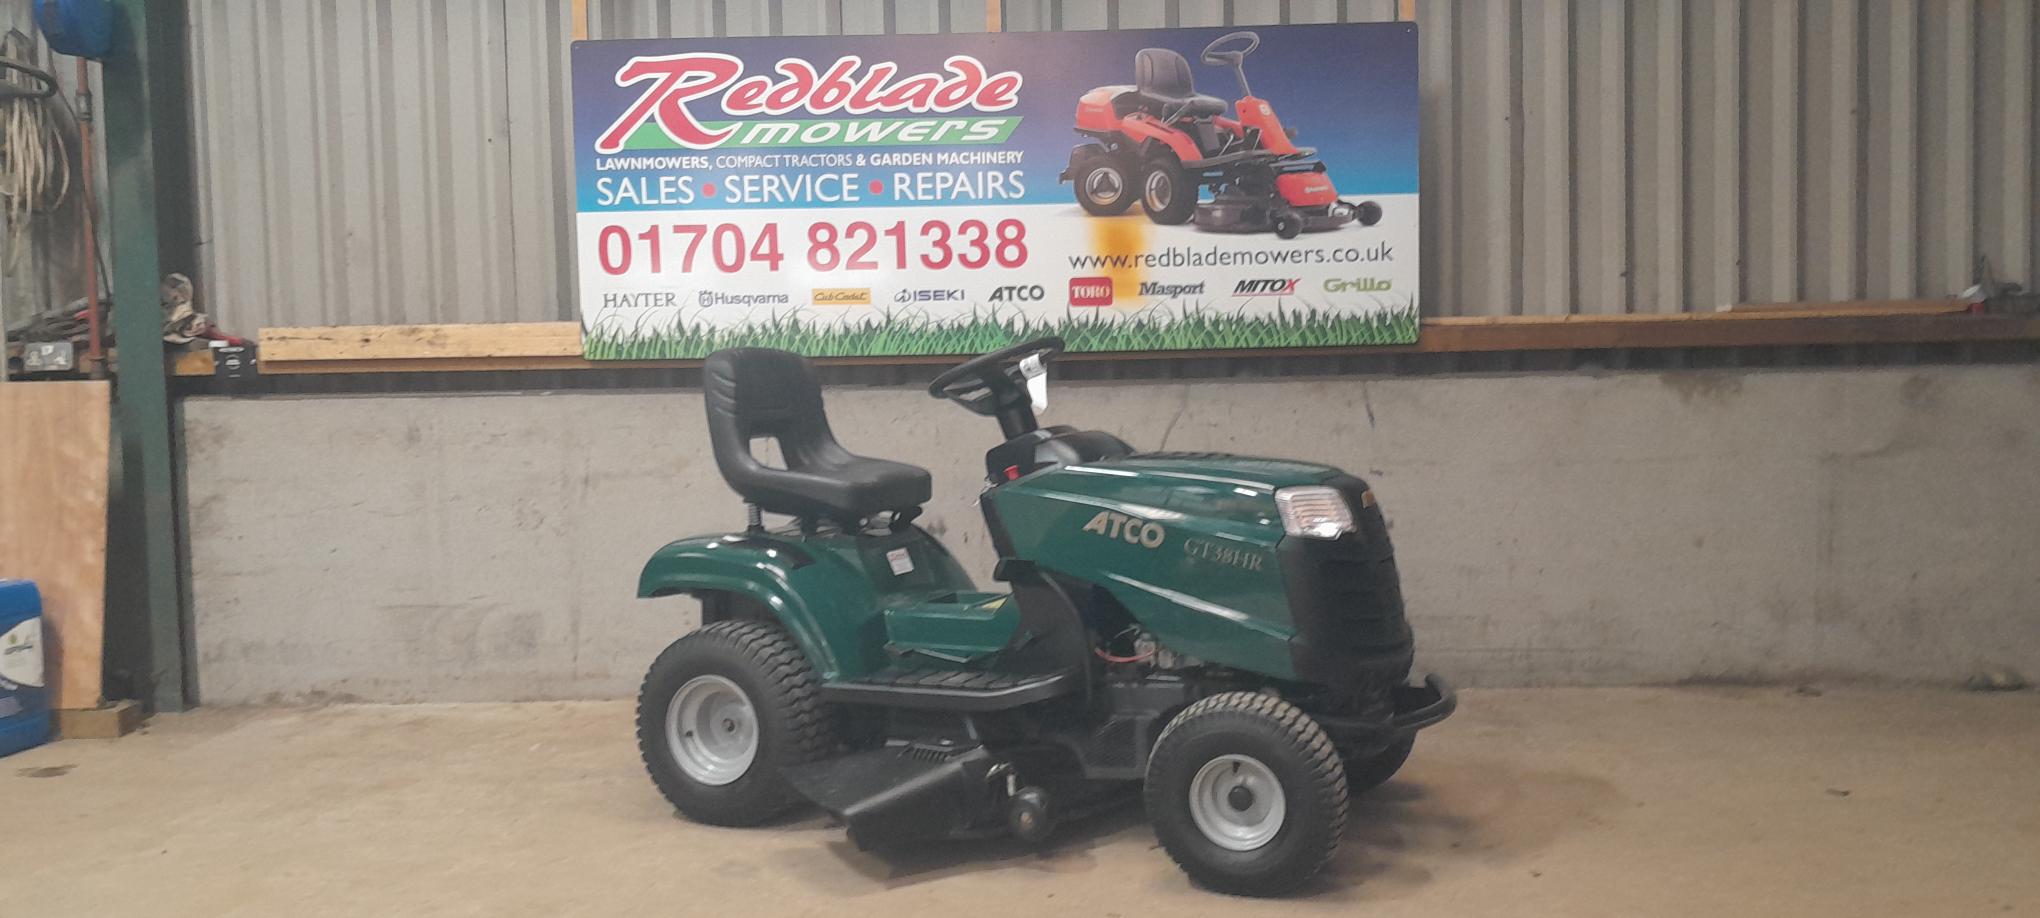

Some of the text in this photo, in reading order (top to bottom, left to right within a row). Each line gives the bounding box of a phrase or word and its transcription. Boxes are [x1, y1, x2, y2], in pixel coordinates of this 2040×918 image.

[595, 52, 1023, 154] Redblade
[596, 150, 1024, 171] LAWNMOWERS, COMPACT TRACTORS & GARDEN MACHINERY
[596, 170, 1025, 206] SALES SERVICE REPAIRS
[598, 218, 1028, 275] 01704 821338
[1068, 241, 1393, 270] www.redblademowers.co.uk
[988, 285, 1045, 302] ATCO
[1071, 285, 1111, 299] TORO
[1138, 280, 1205, 299] Masport
[1233, 277, 1301, 294] MITOX
[1322, 278, 1393, 292] Grillo
[603, 292, 677, 308] HAYTER
[715, 293, 789, 306] Husqvarna
[913, 289, 965, 301] ISEKI
[1083, 510, 1166, 549] ATCO
[1183, 537, 1264, 571] GT38HR
